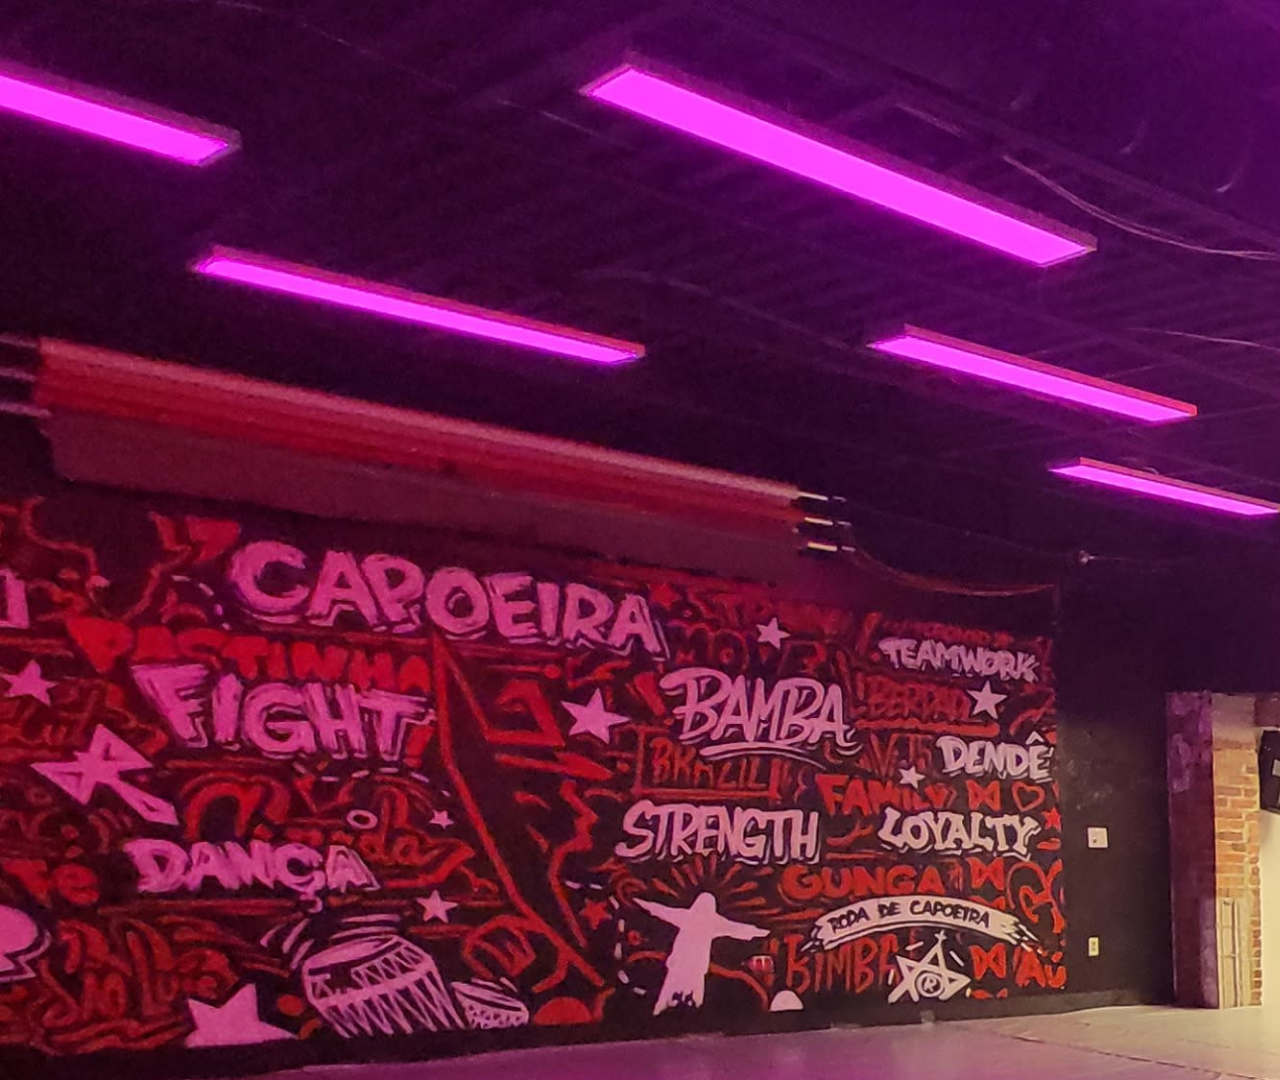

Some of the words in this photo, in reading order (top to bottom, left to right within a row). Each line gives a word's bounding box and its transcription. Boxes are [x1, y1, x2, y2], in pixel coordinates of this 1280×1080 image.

[229, 541, 665, 657] CAPOEIRA
[879, 637, 1041, 683] TEAMWORK
[132, 663, 433, 759] FIGHT
[660, 667, 858, 748] BAMBA
[936, 731, 1054, 781] DENDÊ
[814, 774, 955, 816] FAMILY
[616, 800, 823, 864] STRENGTH
[878, 806, 1041, 860] LOYALTY
[780, 866, 946, 901] GUNGA
[829, 907, 870, 933] RODA
[877, 901, 902, 918] DE
